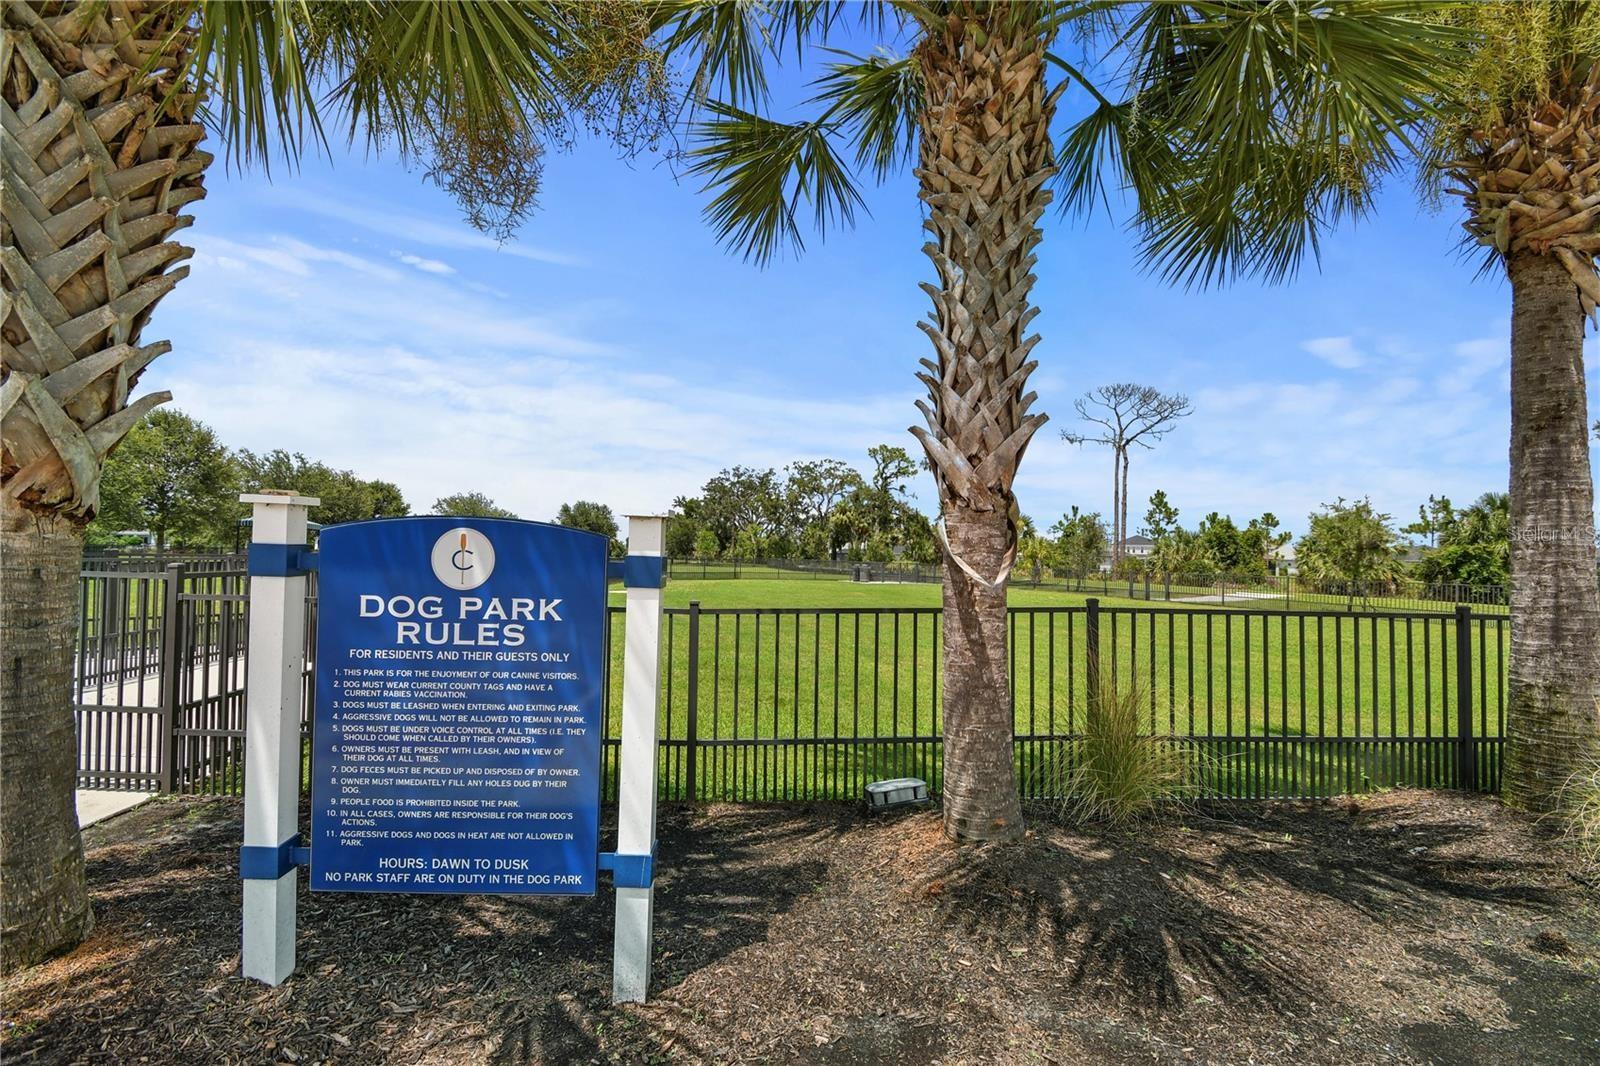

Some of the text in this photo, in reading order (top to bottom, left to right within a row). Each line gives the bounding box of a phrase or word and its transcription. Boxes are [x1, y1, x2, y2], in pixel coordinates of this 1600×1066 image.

[359, 594, 562, 620] DOG PARK
[396, 621, 524, 645] RULES
[349, 649, 569, 662] FOR RESIDENTS AND THEIR GUESTS ONLY
[379, 857, 528, 869] HOURS: DAWN TO DUSK
[325, 872, 581, 884] NO PARK STAFF ARE ON DUTY IN THE DOG PARK
